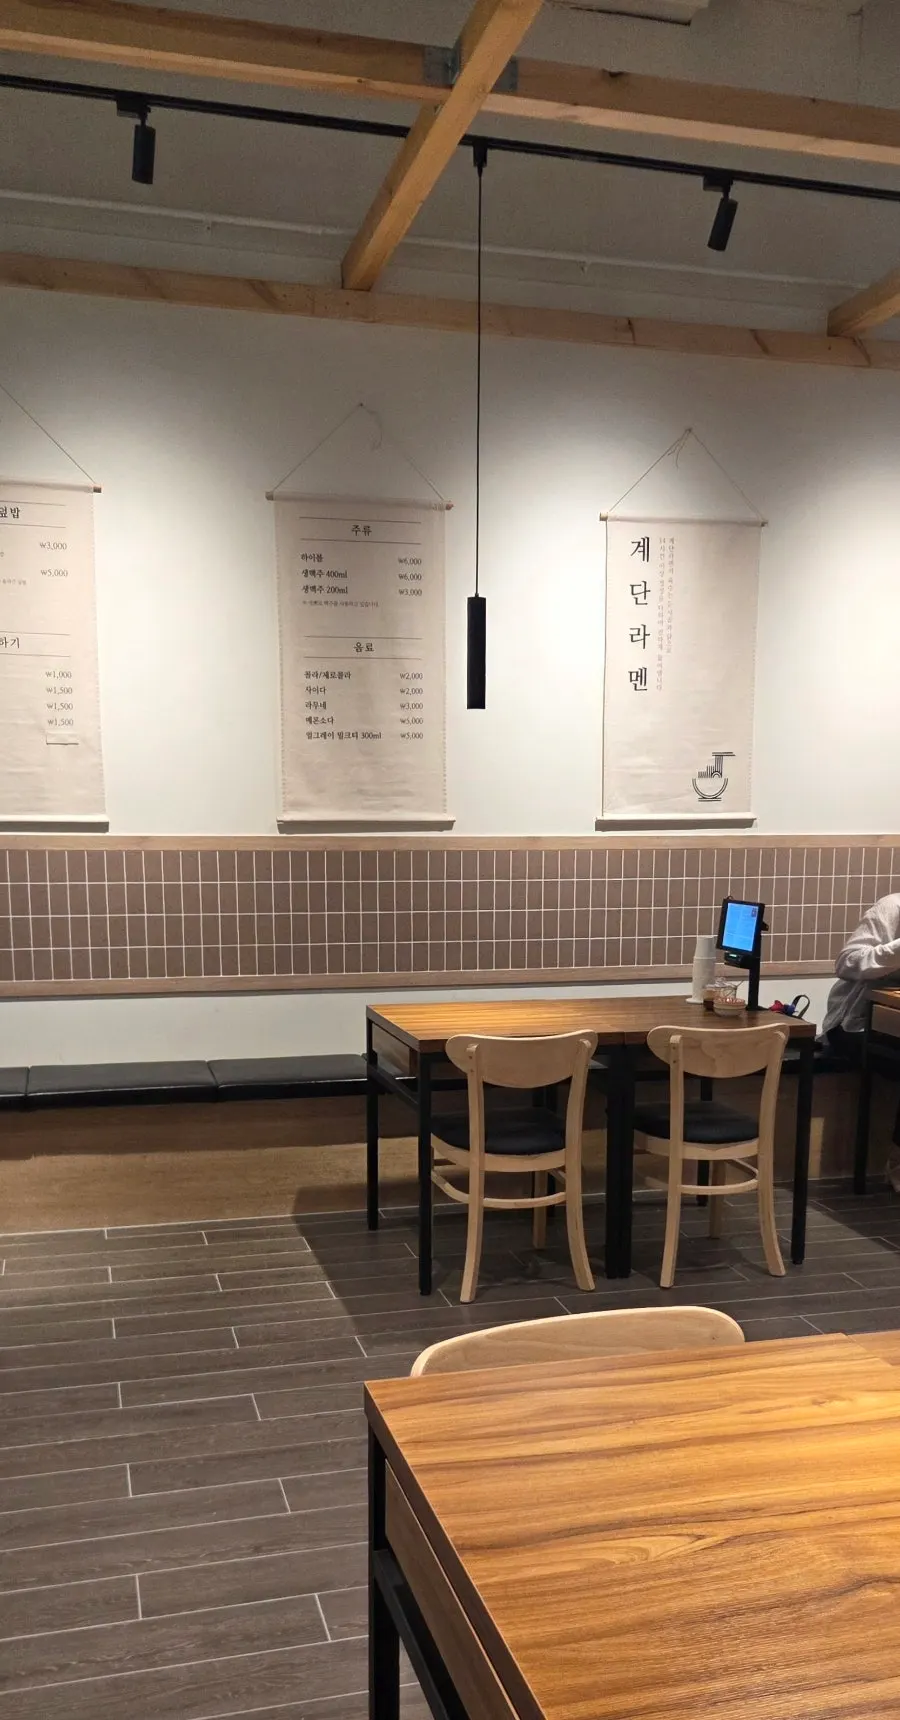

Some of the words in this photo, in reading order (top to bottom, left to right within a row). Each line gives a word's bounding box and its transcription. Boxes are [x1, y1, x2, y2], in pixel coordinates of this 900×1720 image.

[351, 524, 373, 537] 주류
[301, 552, 323, 563] 하이볼
[302, 568, 324, 579] 생맥주
[326, 569, 347, 580] 400ml
[302, 584, 324, 595] 생맥주
[327, 584, 348, 595] 200ml
[628, 535, 653, 692] 계단라멘
[353, 641, 375, 653] 음료
[304, 670, 351, 681] 콜라/제로콜라
[305, 685, 327, 696] 사이다
[305, 700, 327, 711] 라무네
[306, 730, 335, 741] 얼그레이
[337, 730, 359, 741] 밀크티
[361, 730, 382, 741] 300ml
